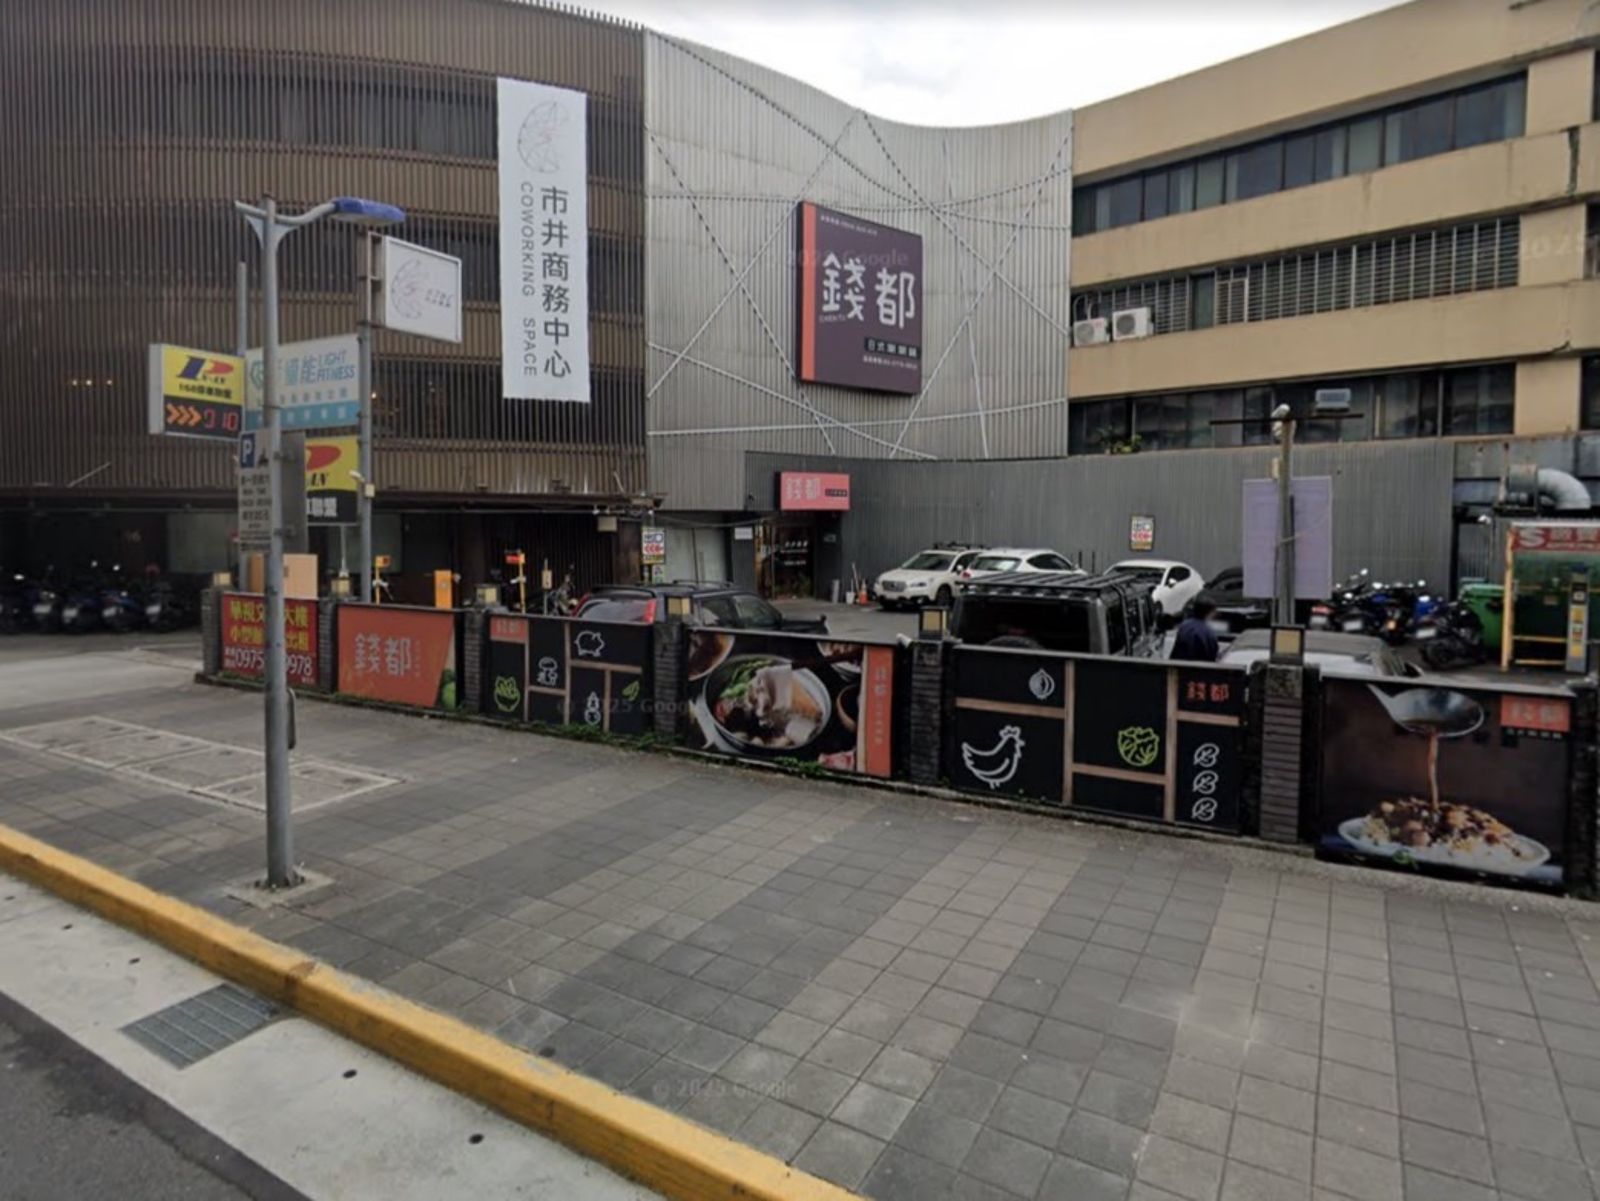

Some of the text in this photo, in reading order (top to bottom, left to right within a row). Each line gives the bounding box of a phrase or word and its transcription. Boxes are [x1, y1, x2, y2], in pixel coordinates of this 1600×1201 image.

[520, 181, 537, 377] COWORKING SPACE
[540, 186, 571, 379] 市井商務中心
[821, 251, 915, 329] 錢都
[317, 364, 355, 382] FITNESS
[319, 350, 346, 367] LIGHT
[242, 439, 253, 463] P
[235, 648, 312, 676] 0975978
[354, 632, 412, 677] 錢都
